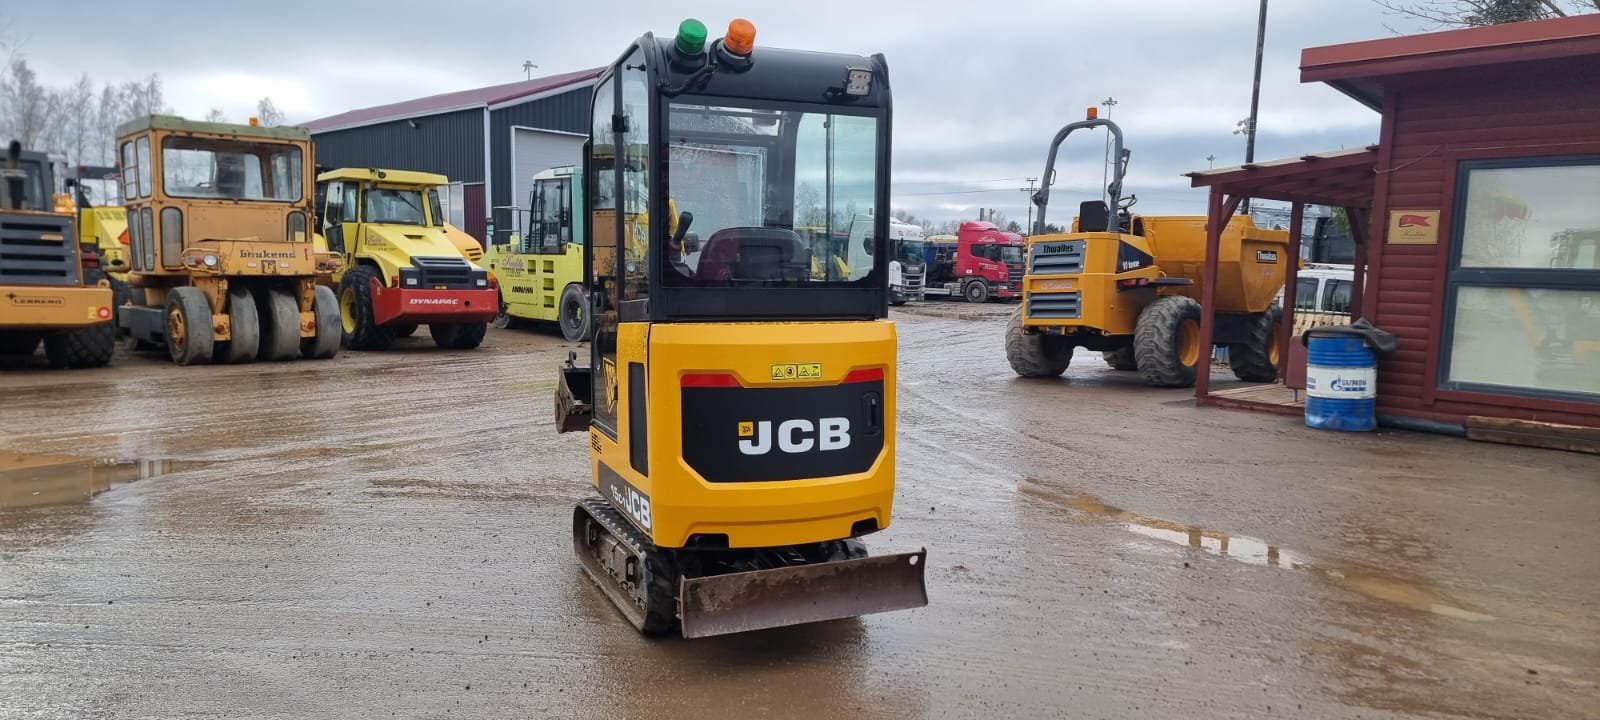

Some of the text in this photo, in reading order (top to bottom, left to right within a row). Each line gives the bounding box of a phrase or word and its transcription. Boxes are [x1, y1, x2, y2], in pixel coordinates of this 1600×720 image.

[1043, 244, 1074, 254] Thwaites
[738, 417, 852, 456] JCB
[625, 486, 651, 529] JCB
